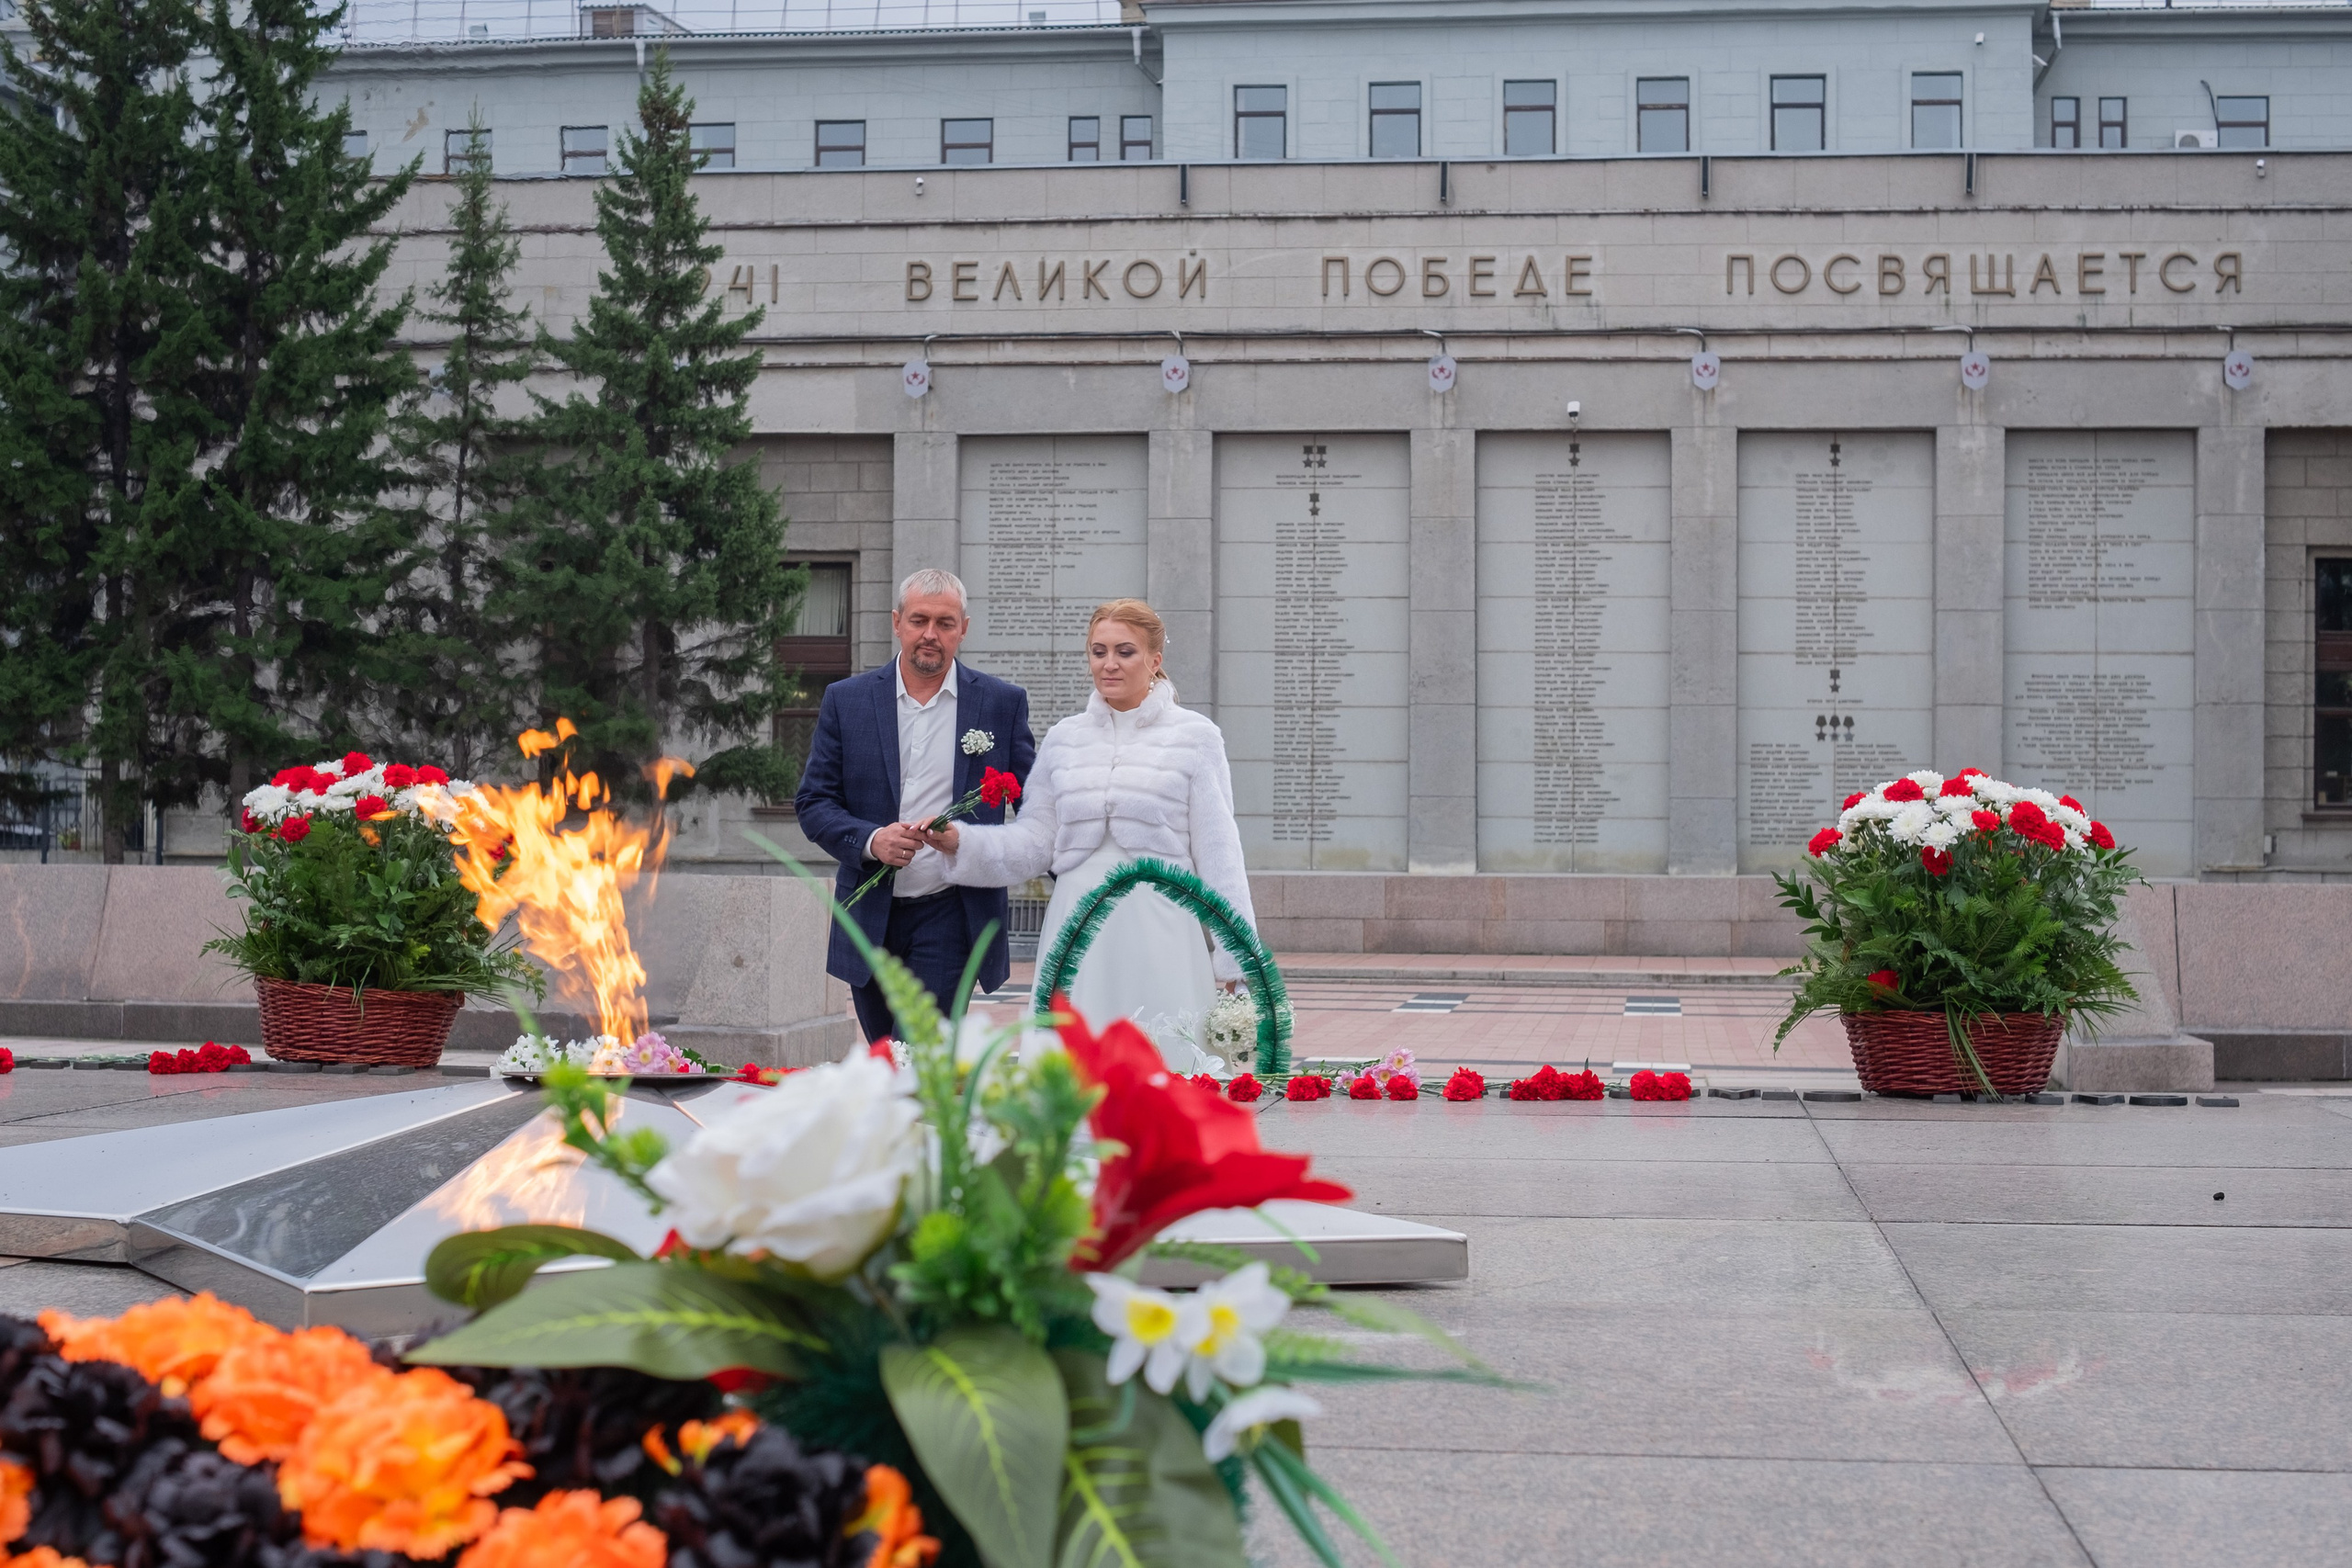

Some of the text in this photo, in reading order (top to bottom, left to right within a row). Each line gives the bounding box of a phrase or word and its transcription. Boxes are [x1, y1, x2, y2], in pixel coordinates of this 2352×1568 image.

[905, 249, 1207, 301] ВЕЛИКОЙ
[1321, 254, 1593, 298] ПОБЕДЕ
[1726, 251, 2243, 298] ПОСВЯЩАЕТСЯ
